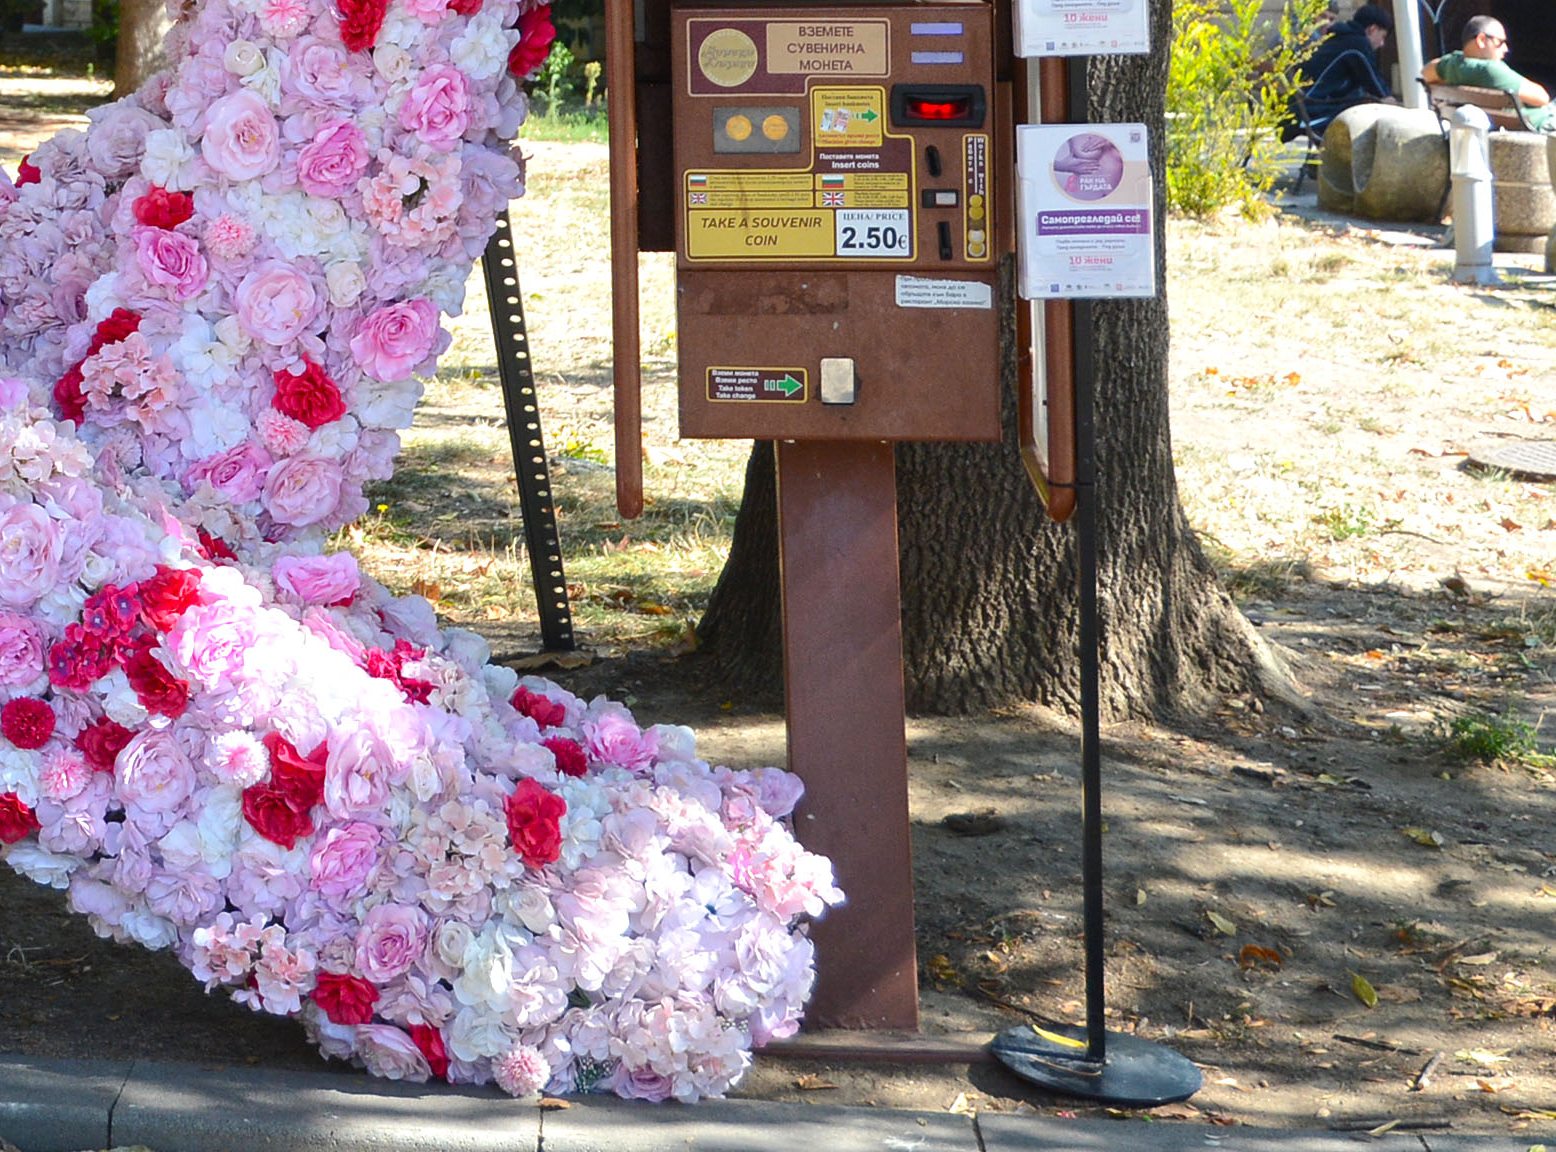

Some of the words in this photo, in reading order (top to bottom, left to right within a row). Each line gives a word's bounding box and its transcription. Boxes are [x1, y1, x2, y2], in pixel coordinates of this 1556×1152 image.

[1064, 13, 1077, 22] 10
[798, 26, 854, 37] ВЗЕМЕТЕ
[787, 43, 865, 54] СУВЕНИРНА
[799, 60, 853, 71] МОНЕТА
[832, 161, 855, 169] Insert
[856, 161, 880, 169] coins
[701, 217, 736, 228] TAKE
[738, 217, 749, 228] A
[751, 216, 822, 228] SOUVENIR
[843, 213, 874, 221] ЦЕНА/
[1041, 214, 1123, 224] Самопрегледай
[745, 235, 778, 246] COIN
[732, 392, 756, 400] change
